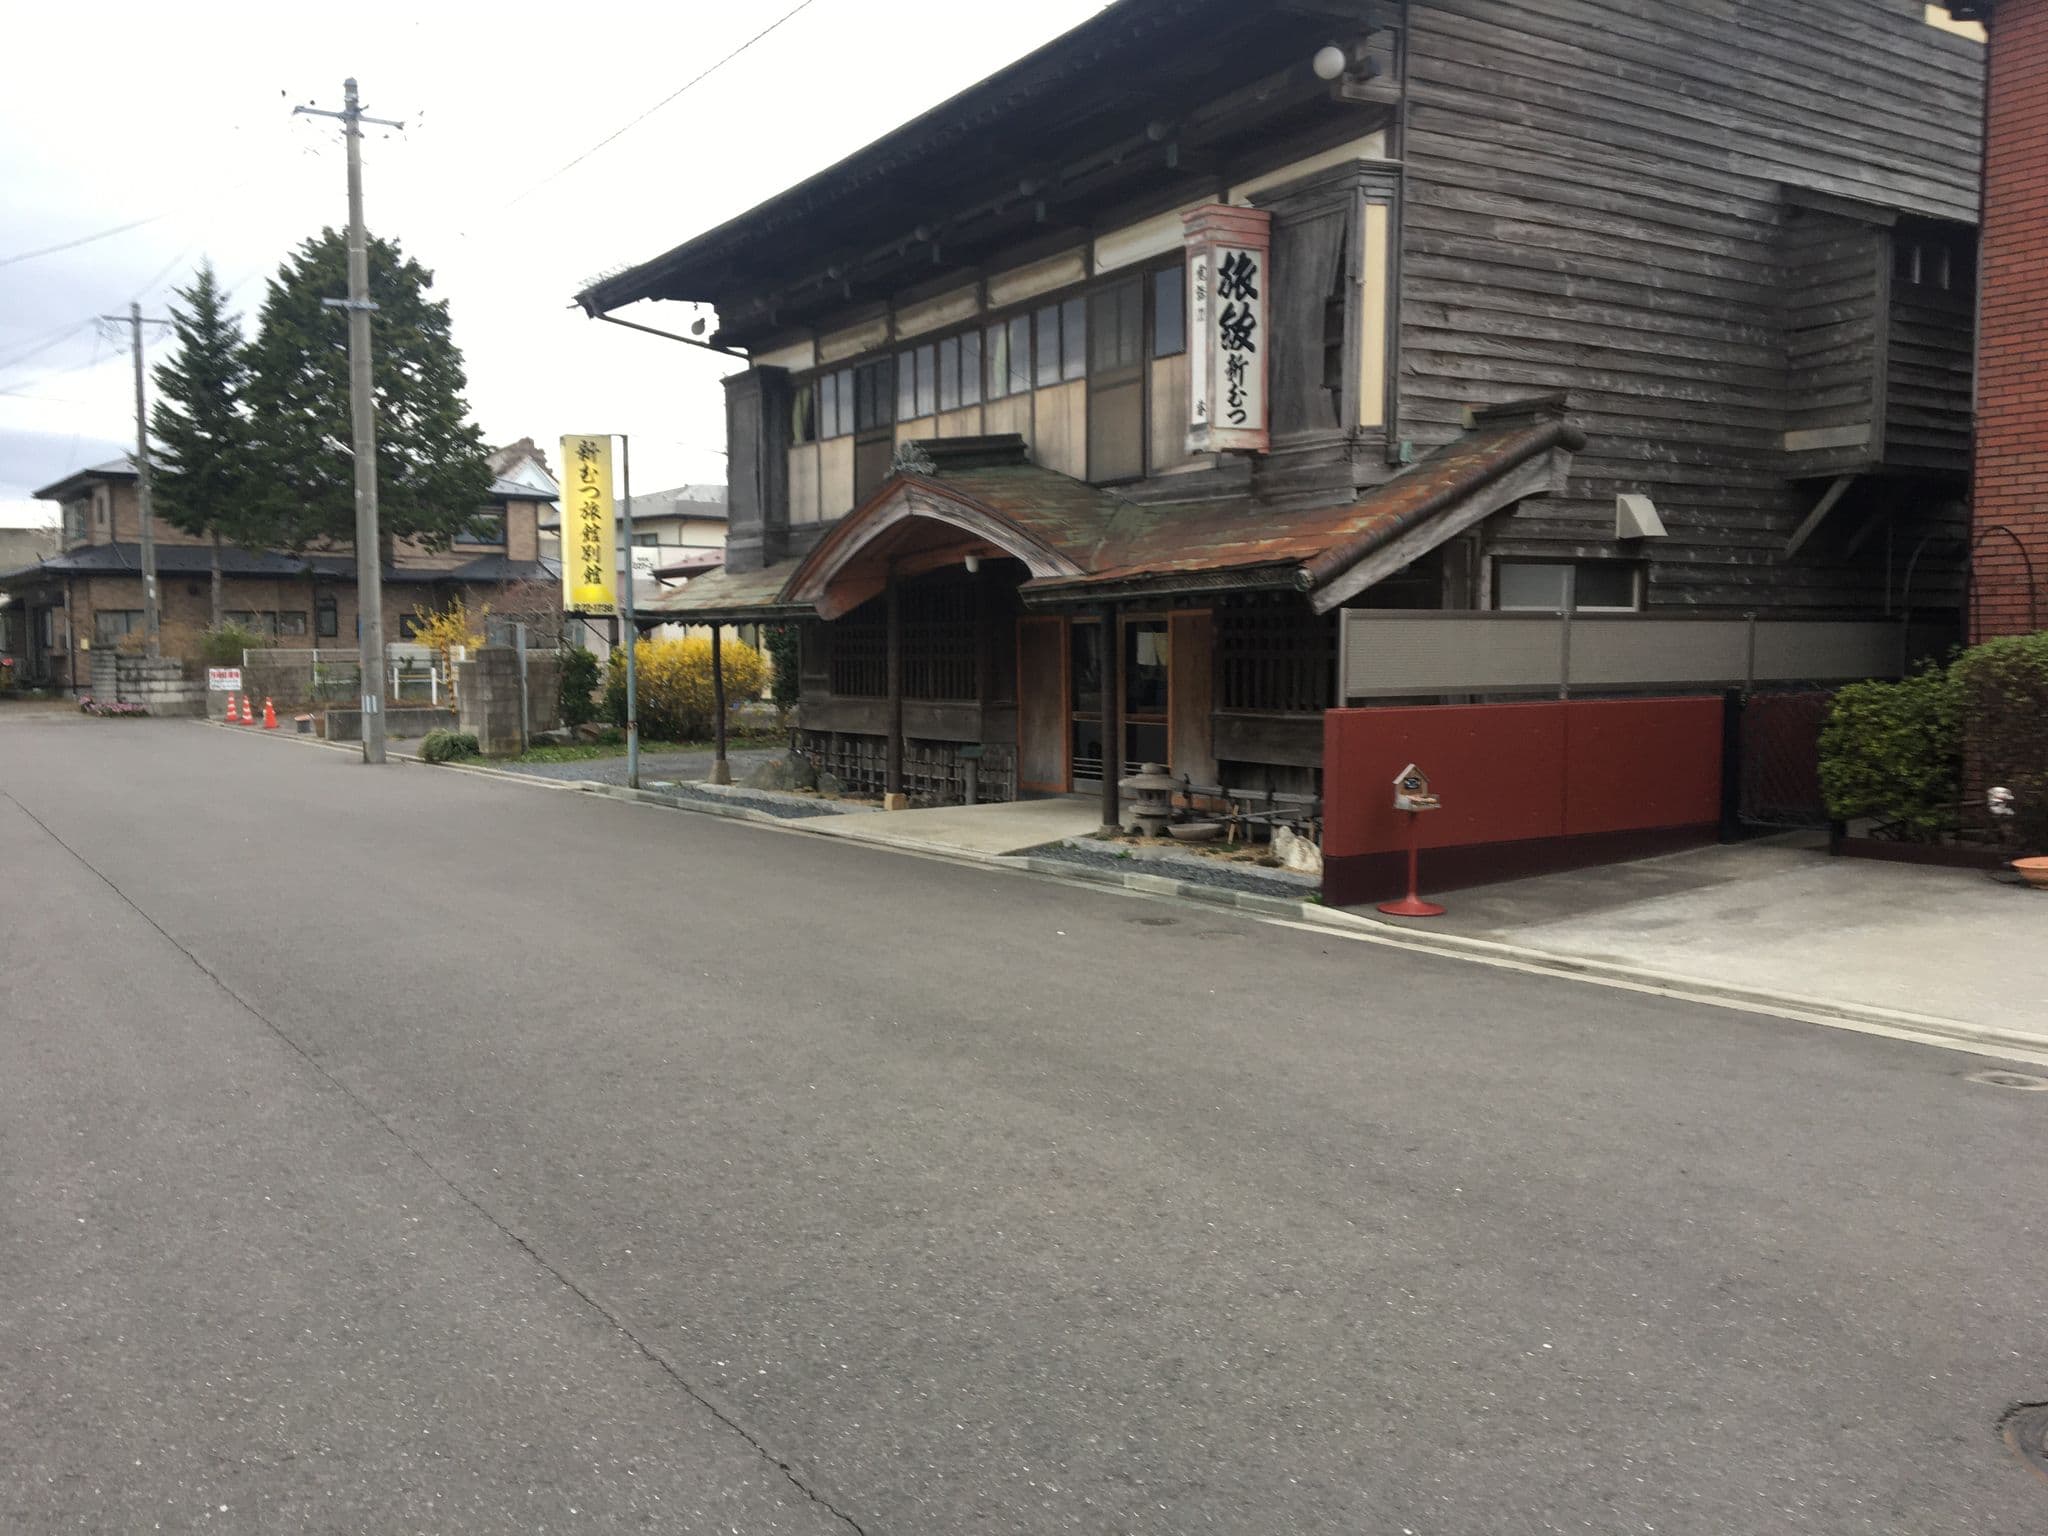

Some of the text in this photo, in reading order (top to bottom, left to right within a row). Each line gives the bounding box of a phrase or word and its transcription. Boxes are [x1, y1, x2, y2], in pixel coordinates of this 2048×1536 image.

[575, 439, 603, 585] 新むつ旅館別館
